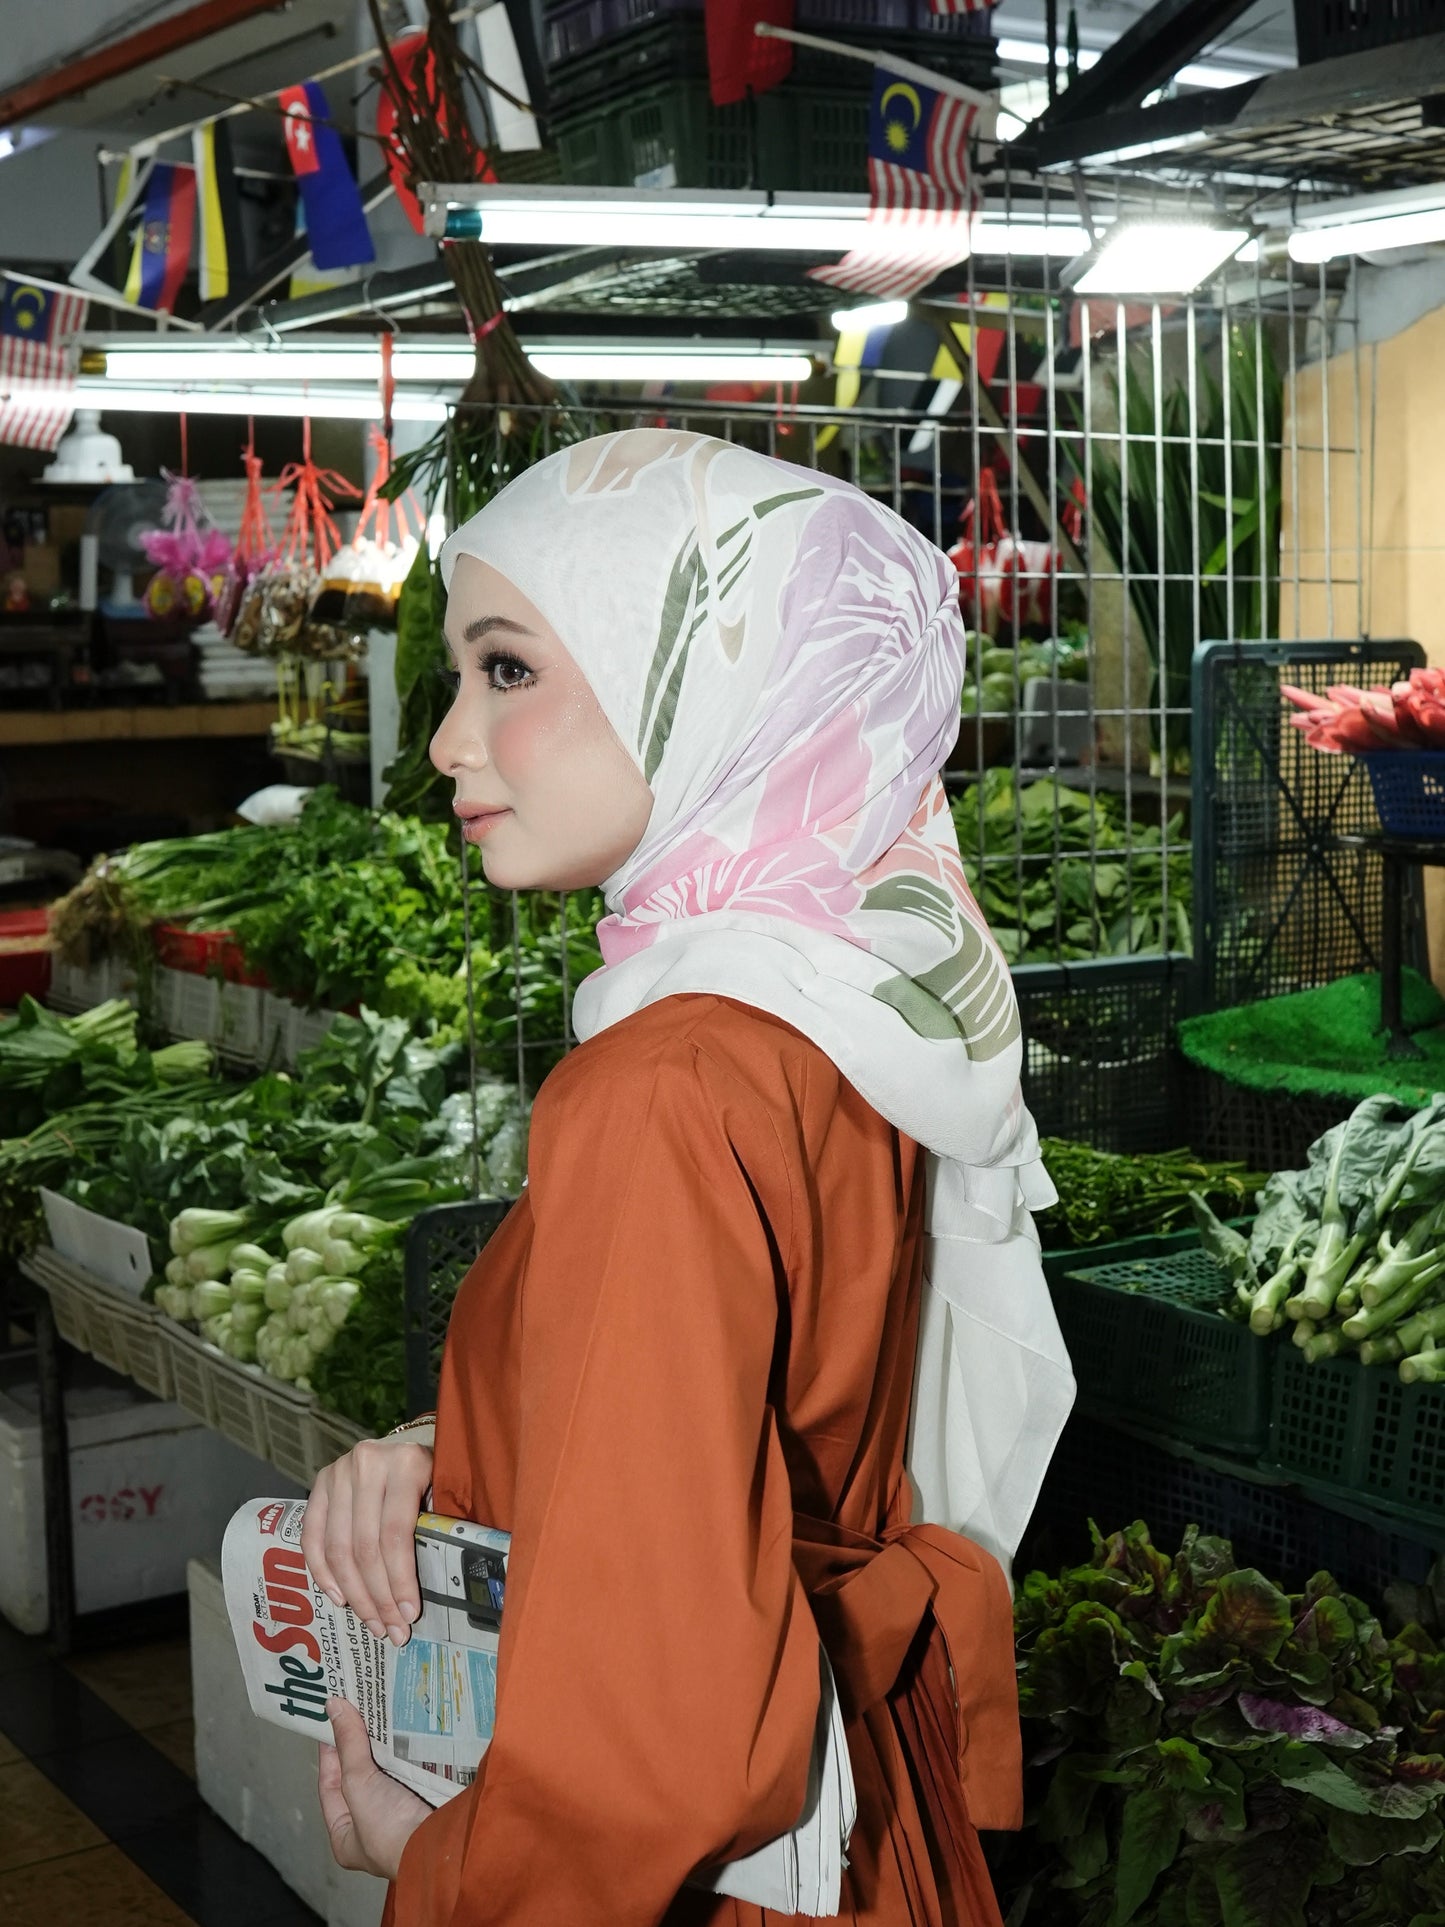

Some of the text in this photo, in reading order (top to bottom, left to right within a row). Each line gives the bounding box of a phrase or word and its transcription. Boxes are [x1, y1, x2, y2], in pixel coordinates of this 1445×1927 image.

[253, 1593, 262, 1618] FRIDAY
[327, 1613, 335, 1631] COPY
[347, 1633, 358, 1645] of
[358, 1622, 375, 1738] proposed to restore
[374, 1681, 382, 1709] corporal
